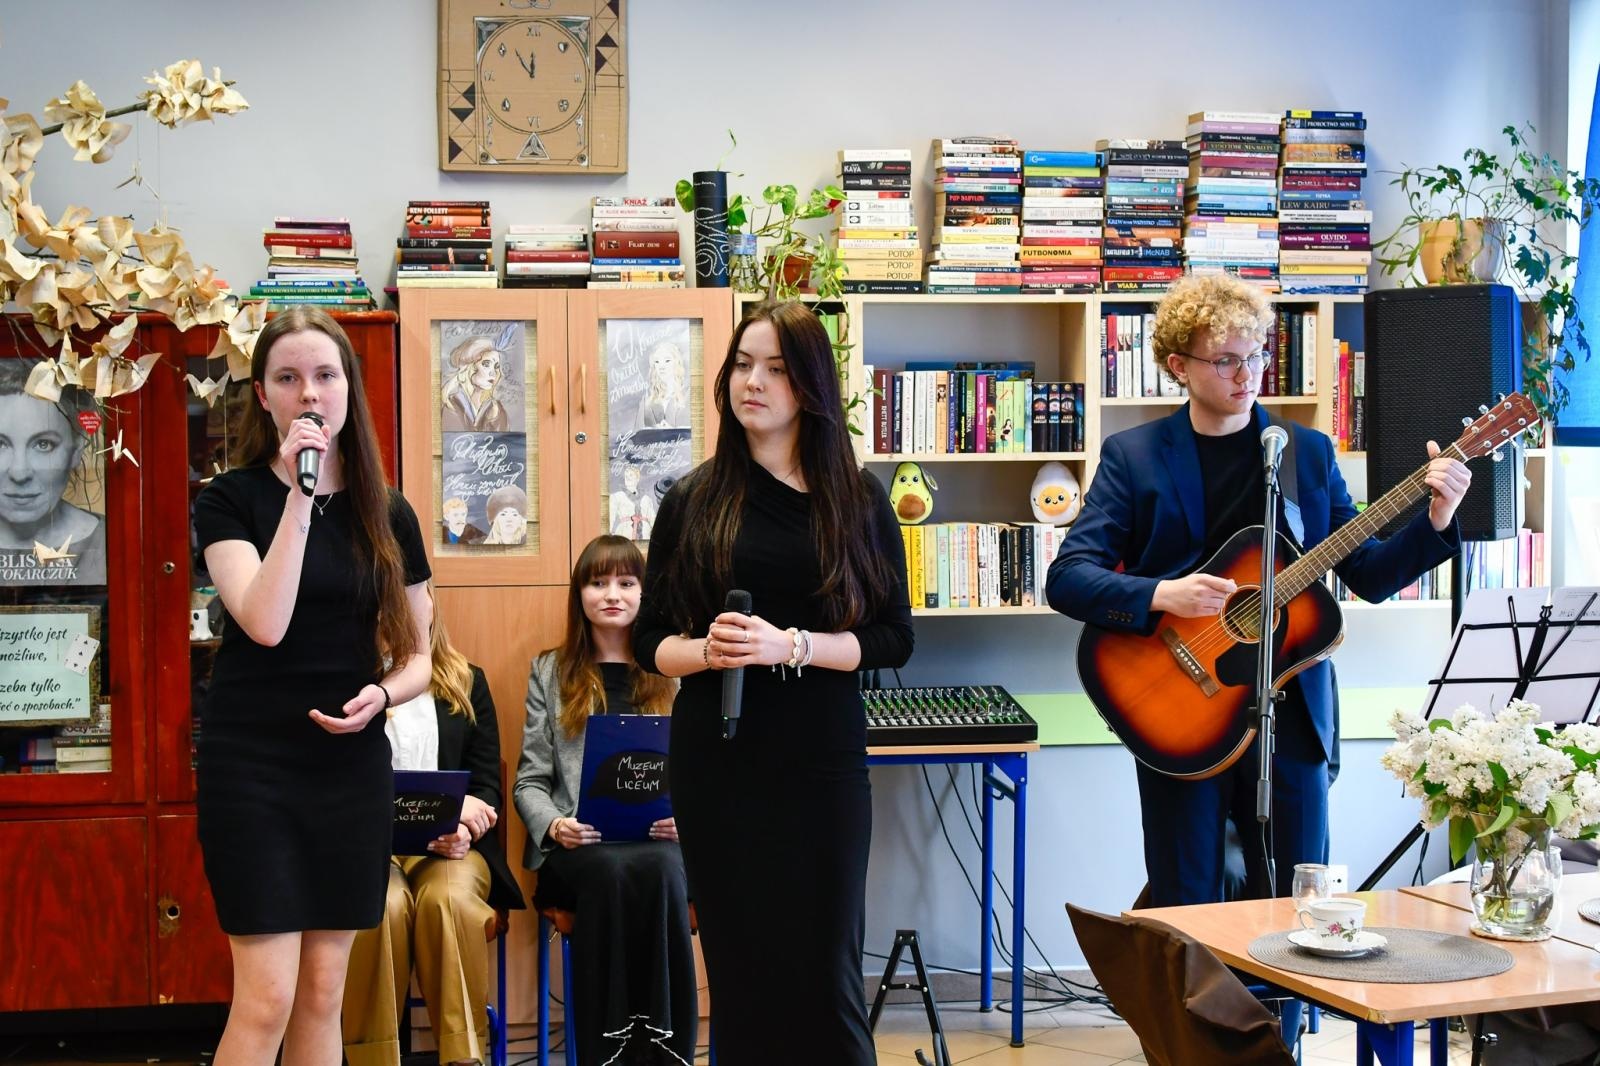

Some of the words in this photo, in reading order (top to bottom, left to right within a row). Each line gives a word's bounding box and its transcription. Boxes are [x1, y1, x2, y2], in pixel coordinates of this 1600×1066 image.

[1282, 201, 1302, 209] LEW
[1303, 201, 1330, 209] KAIRU
[1320, 233, 1347, 241] OLVIDO
[888, 250, 915, 258] POTOP
[887, 261, 914, 269] POTOP
[886, 272, 913, 280] POTOP
[0, 554, 73, 568] BLISA
[0, 626, 44, 645] szystko
[44, 627, 68, 644] jest
[30, 678, 61, 697] tylko
[13, 703, 21, 711] o
[617, 755, 665, 772] MUZEUM
[616, 777, 661, 792] LICEUM
[394, 813, 436, 822] ICEUM
